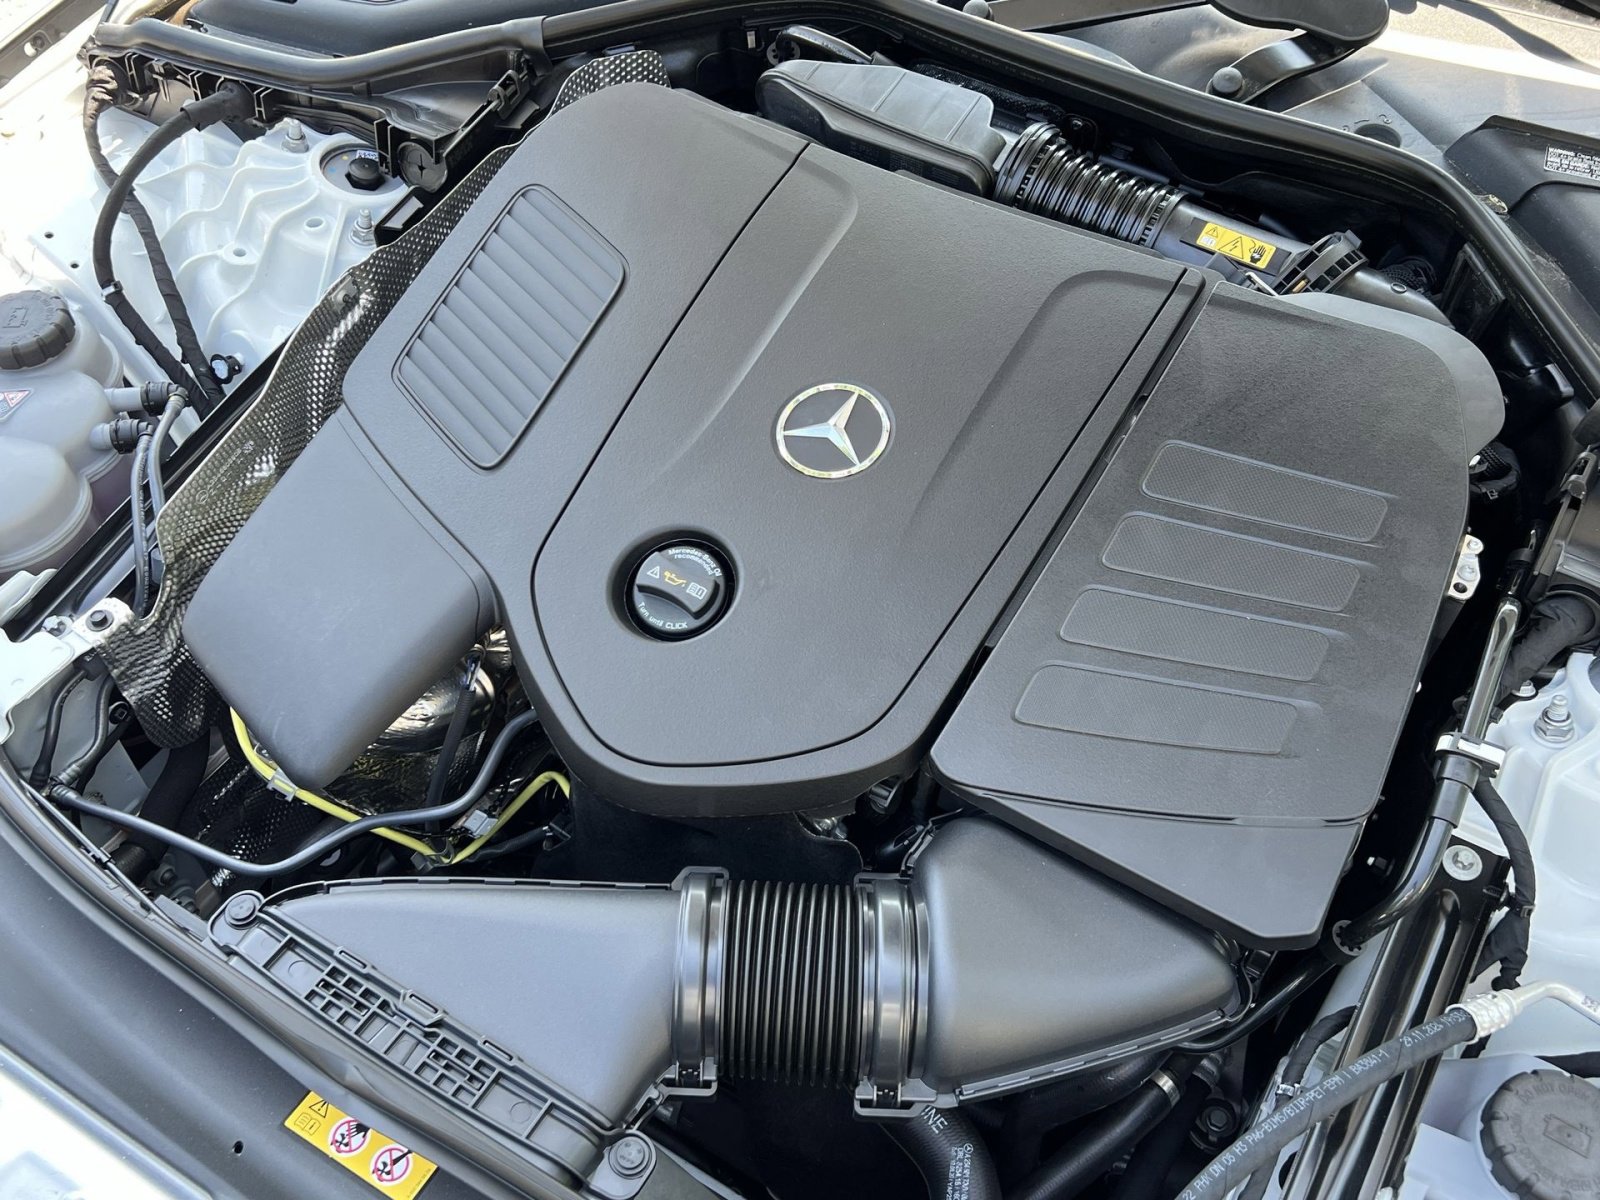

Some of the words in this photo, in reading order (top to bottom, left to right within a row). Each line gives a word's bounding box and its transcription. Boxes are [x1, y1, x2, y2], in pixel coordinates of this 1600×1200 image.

[668, 549, 716, 569] Mercedes-Benz
[674, 554, 714, 575] recommended
[638, 601, 650, 617] Turn
[649, 616, 664, 627] until
[665, 621, 688, 630] CLICK
[1209, 1164, 1225, 1177] DN
